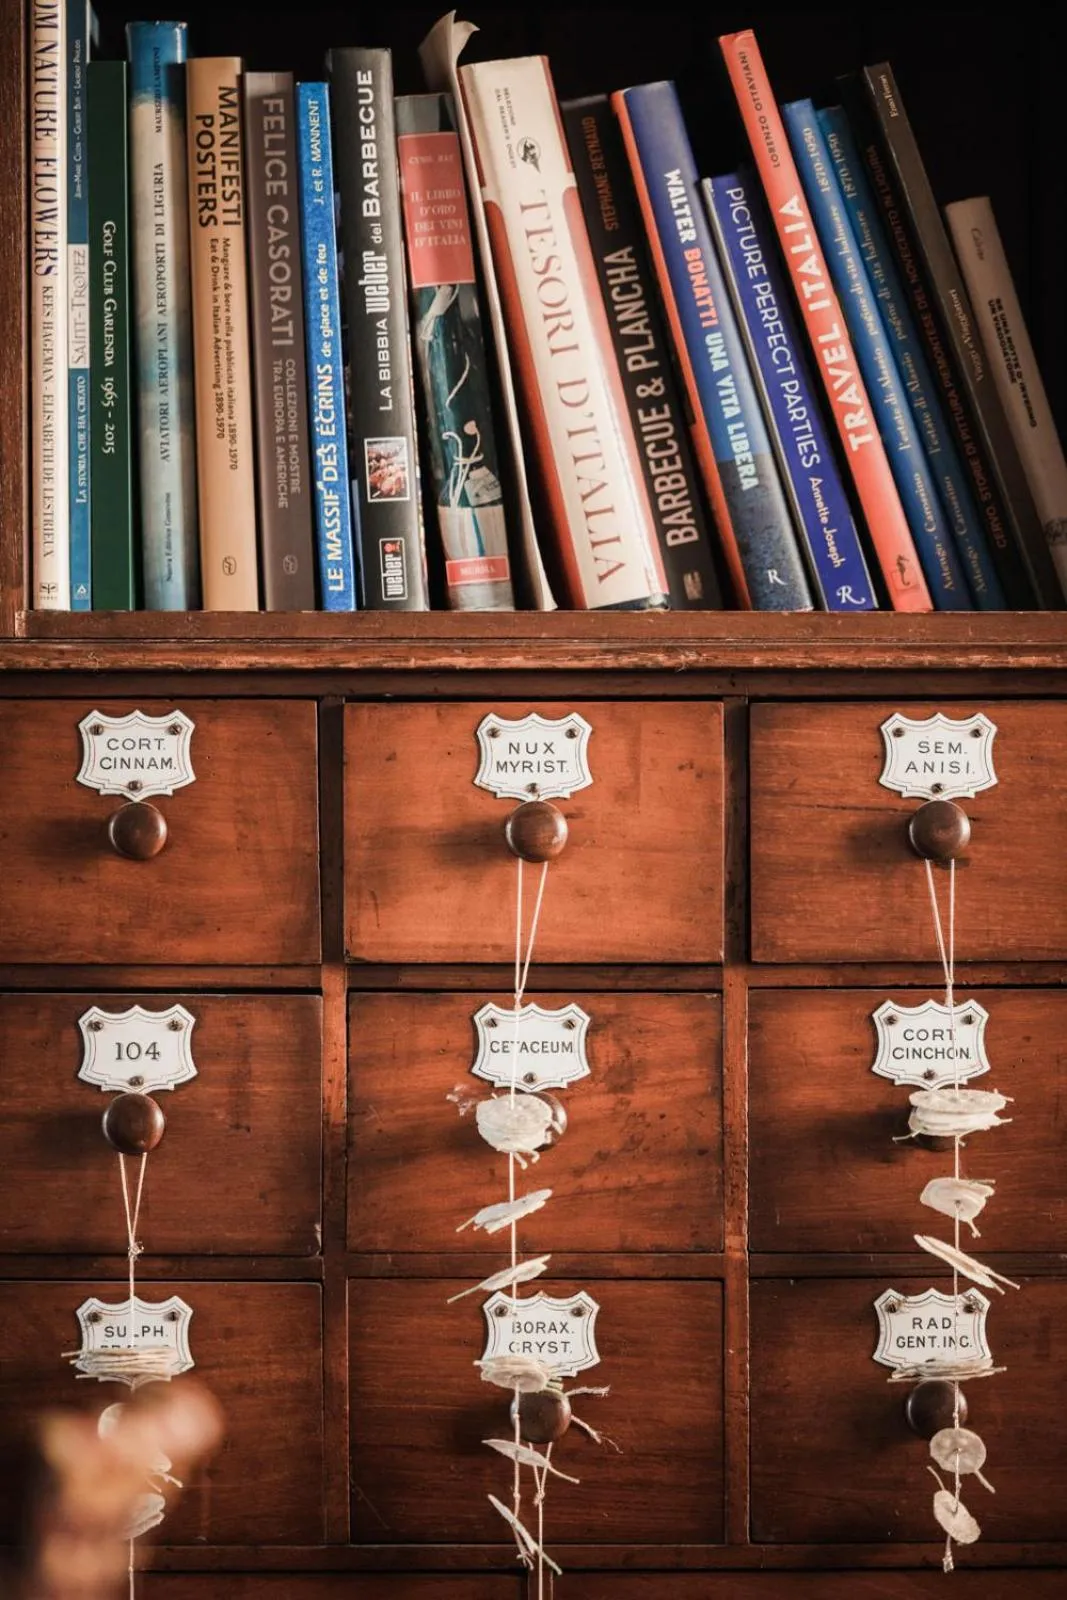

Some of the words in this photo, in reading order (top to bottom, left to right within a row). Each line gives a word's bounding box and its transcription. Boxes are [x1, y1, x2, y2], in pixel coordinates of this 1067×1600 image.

[34, 40, 58, 141] NATURE
[738, 51, 763, 111] OTTAVIANI
[263, 98, 288, 196] FELICE
[308, 99, 322, 162] MANNENT
[356, 70, 381, 217] BARBECUE
[759, 115, 781, 168] LORENZO
[195, 114, 218, 228] POSTERS
[218, 86, 241, 226] MANIFESTI
[802, 127, 832, 193] 1870-1950
[827, 132, 857, 198] 1870-1950
[153, 163, 161, 217] LIGURIA
[314, 180, 324, 192] et
[410, 191, 423, 202] IL
[426, 189, 461, 201] LIBRO
[34, 157, 58, 276] FLOWERS
[420, 205, 457, 216] D'ORO
[664, 168, 697, 244] WALTER
[103, 221, 116, 257] GOLF
[154, 223, 166, 236] DI
[370, 223, 383, 244] del
[414, 221, 435, 232] DEI
[438, 219, 463, 230] VINI
[414, 235, 466, 248] D'ITALIA
[209, 238, 218, 256] Eat
[221, 237, 231, 281] Mangiare
[316, 243, 327, 265] feu
[778, 194, 832, 312] ITALIA
[887, 208, 917, 284] NOVECENTO
[103, 261, 117, 295] CLUB
[154, 243, 167, 317] AEROPORTI
[211, 265, 219, 293] Drink
[267, 204, 294, 346] CASORATI
[317, 268, 328, 284] de
[846, 257, 860, 280] vita
[42, 285, 53, 316] KEES
[213, 295, 220, 303] in
[224, 293, 232, 312] bere
[319, 288, 328, 300] et
[683, 247, 719, 328] BONATTI
[850, 282, 865, 295] di
[877, 287, 891, 300] di
[913, 285, 926, 309] DEL
[224, 315, 233, 337] nella
[319, 304, 333, 338] glace
[603, 245, 659, 373] PLANCHA
[860, 298, 880, 336] pagine
[103, 298, 117, 367] GARLENDA
[321, 341, 332, 357] de
[376, 318, 391, 381] BIBBIA
[922, 312, 952, 387] PIEMONTESE
[42, 321, 54, 383] HAGEMAN
[157, 323, 168, 396] AEROPLANI
[212, 336, 222, 389] Advertising
[704, 331, 729, 373] UNA
[873, 348, 893, 389] Alassio
[273, 359, 283, 382] TRA
[520, 187, 579, 358] TESORI
[556, 377, 627, 584] D'ITALIA
[635, 376, 665, 398] &
[725, 187, 767, 280] PICTURE
[752, 281, 795, 375] PERFECT
[780, 379, 820, 468] PARTIES
[808, 476, 831, 525] Annette
[823, 527, 846, 569] Joseph
[817, 322, 874, 452] TRAVEL
[77, 375, 86, 413] CREATO
[101, 377, 118, 408] 1965
[226, 387, 237, 423] italiana
[273, 387, 285, 433] EUROPA
[285, 358, 298, 432] COLLEZIONI
[379, 386, 393, 411] LA
[716, 374, 741, 419] VITA
[884, 392, 898, 405] di
[913, 396, 927, 409] di
[42, 394, 54, 463] ELISABETH
[77, 415, 87, 429] HA
[215, 392, 225, 439] 1890-1970
[948, 387, 970, 439] PITTURA
[77, 431, 87, 451] CHE
[102, 424, 115, 454] 2015
[159, 402, 170, 462] AVIATORI
[227, 424, 238, 470] 1890-1970
[289, 435, 298, 444] E
[964, 440, 978, 455] DI
[77, 454, 87, 487] STORIA
[289, 445, 301, 494] MOSTRE
[321, 444, 339, 482] DES
[727, 422, 759, 492] LIBERA
[43, 467, 54, 484] DE
[276, 446, 288, 509] AMERICHE
[637, 404, 699, 547] BARBECUE
[970, 456, 993, 501] STORIE
[76, 489, 86, 503] LA
[323, 489, 343, 561] MASSIF
[328, 568, 344, 592] LE
[381, 553, 404, 597] weber
[836, 585, 866, 604] R
[106, 738, 167, 751] CORT.
[508, 742, 555, 755] NUX
[918, 741, 968, 754] SEM.
[100, 757, 177, 770] CINNAM.
[496, 760, 570, 773] MYRIST.
[905, 761, 976, 774] ANISI.
[115, 1041, 161, 1061] 104
[892, 1047, 972, 1060] CINCHON.
[104, 1325, 168, 1338] SUPH.
[511, 1321, 575, 1334] BORAX.
